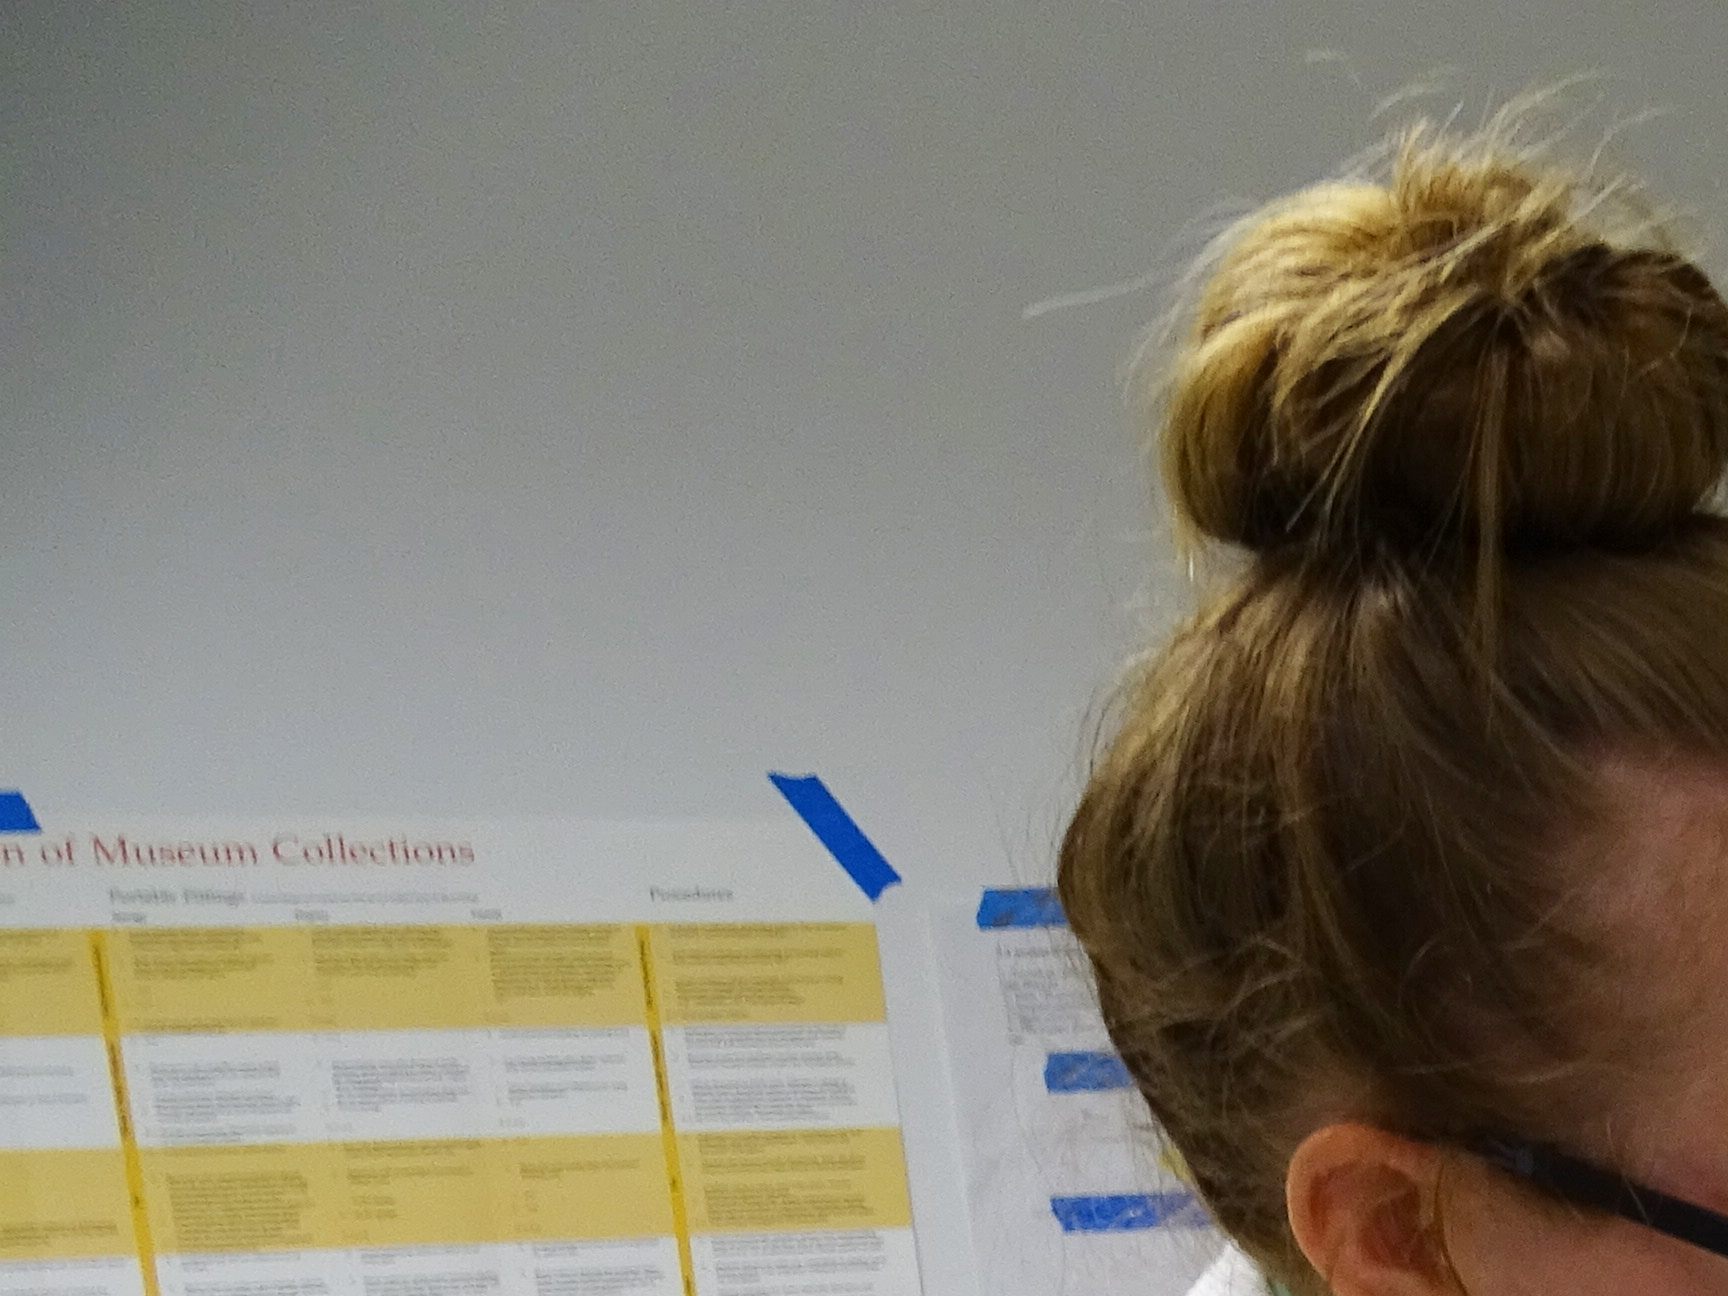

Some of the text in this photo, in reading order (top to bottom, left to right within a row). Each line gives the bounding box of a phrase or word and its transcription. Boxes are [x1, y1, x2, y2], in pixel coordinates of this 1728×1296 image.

[40, 835, 76, 866] of
[91, 834, 259, 868] Museum
[271, 831, 476, 868] Collections
